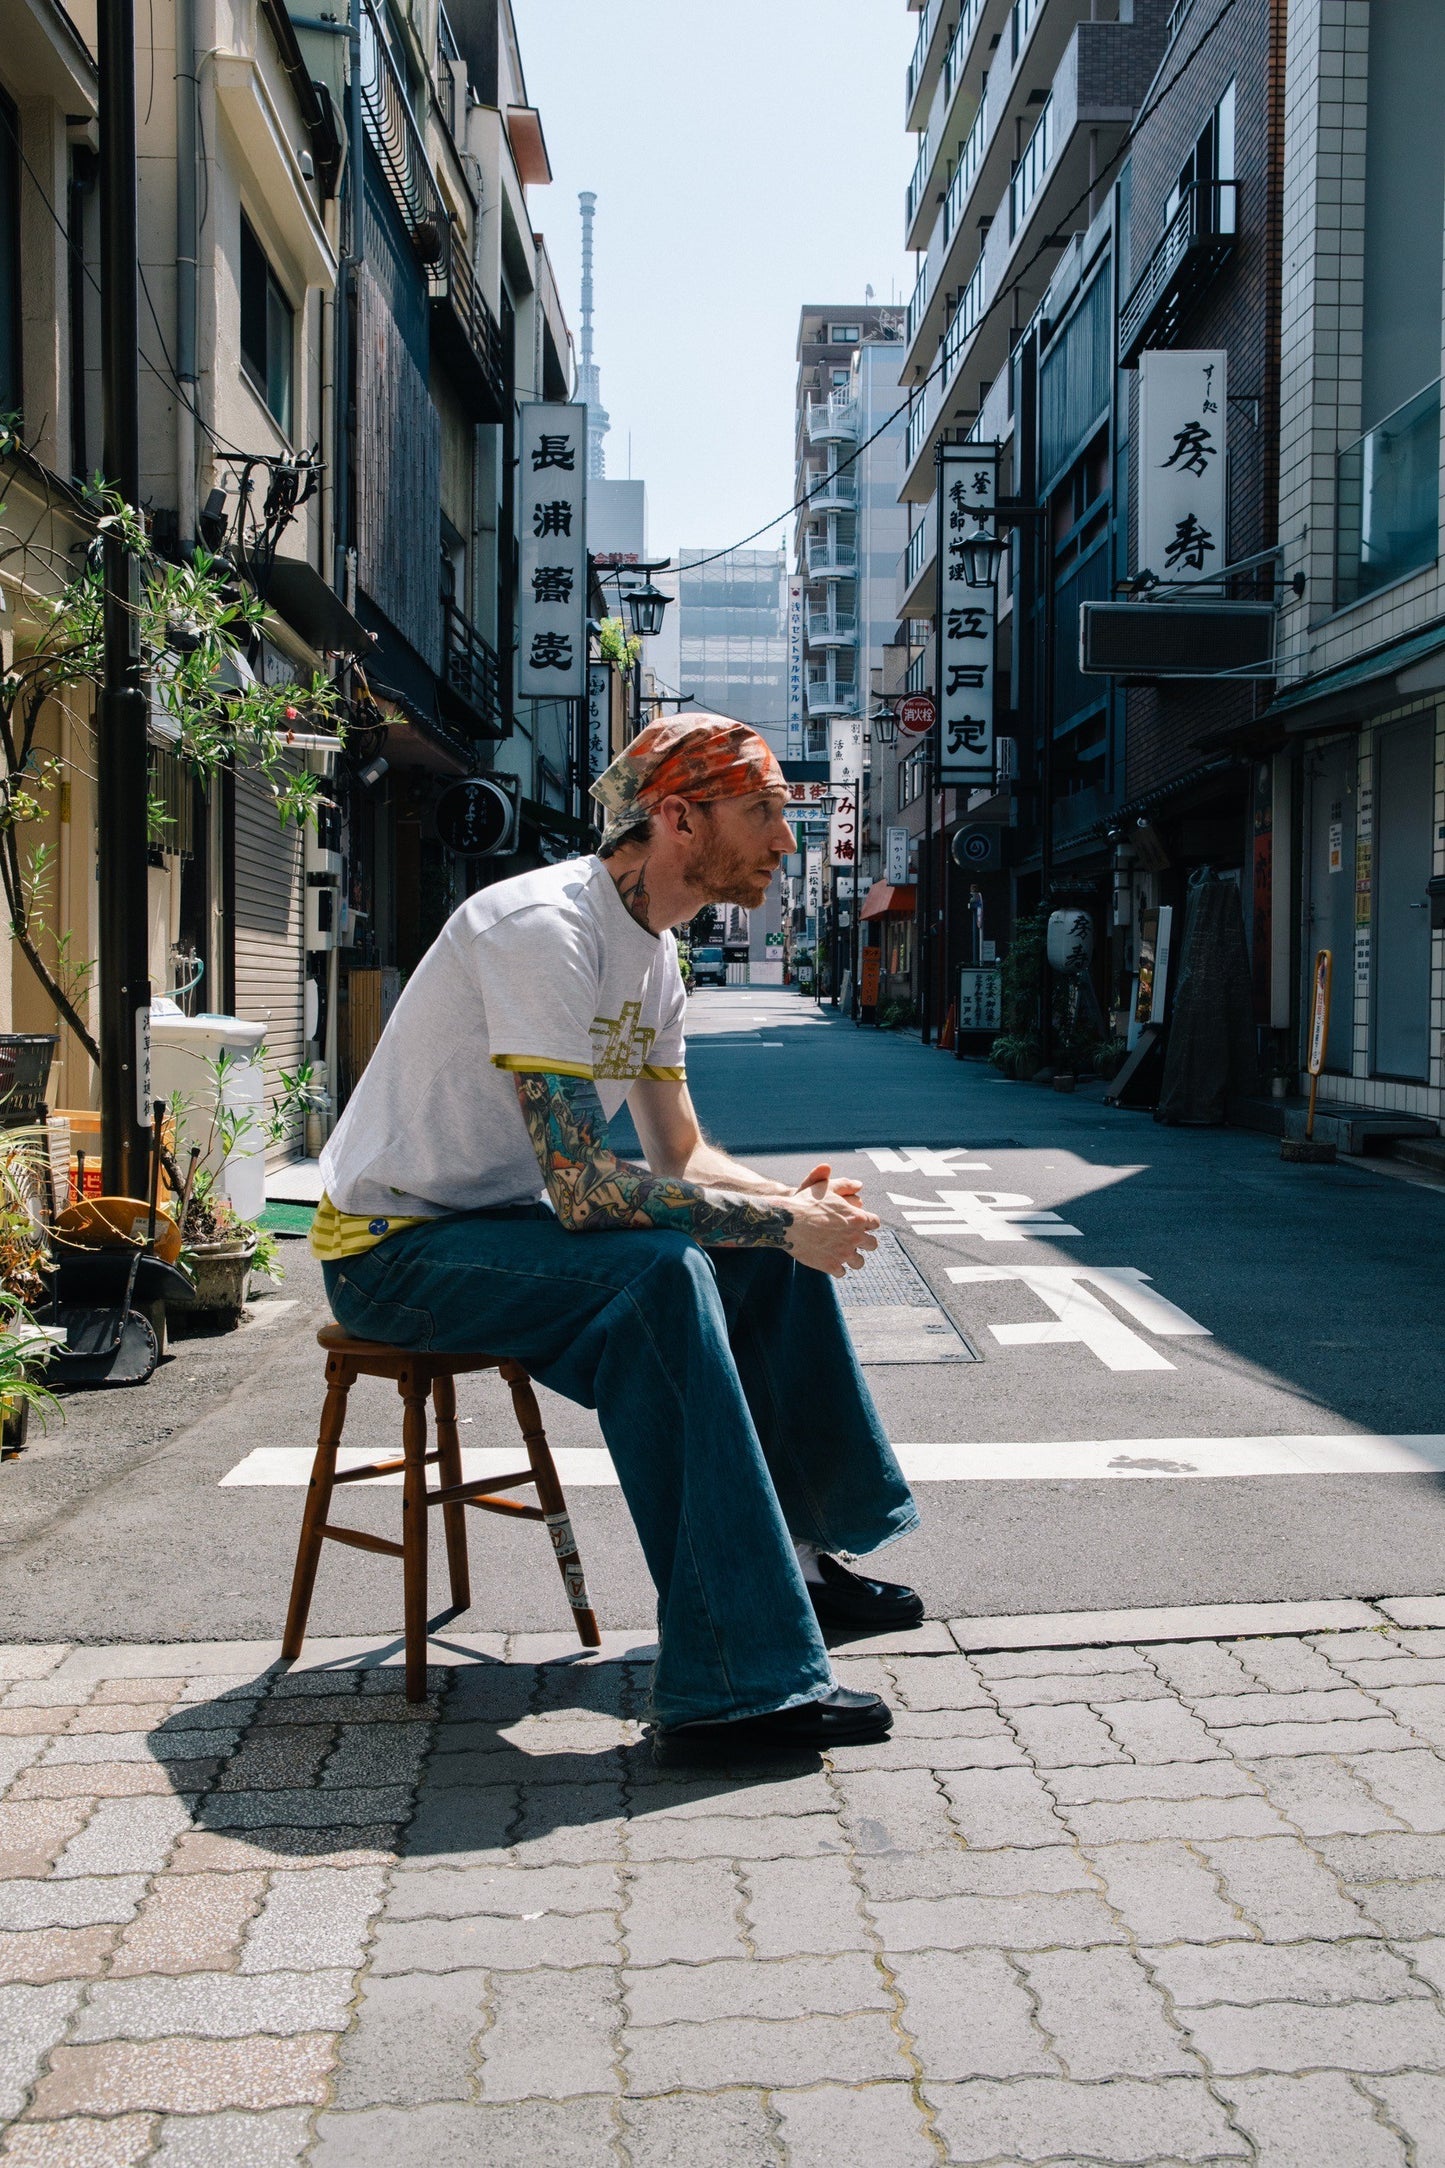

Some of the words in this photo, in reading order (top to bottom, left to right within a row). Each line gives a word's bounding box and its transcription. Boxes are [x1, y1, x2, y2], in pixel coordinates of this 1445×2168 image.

[1202, 364, 1218, 414] すし処
[1154, 420, 1218, 572] 房寿
[529, 434, 575, 672] 長浦蕎麦
[946, 607, 988, 755] 江戸定
[904, 708, 933, 722] 消火栓
[833, 739, 845, 761] 活魚
[834, 796, 856, 861] みつ橋
[1064, 915, 1090, 968] 房寿
[854, 1146, 1214, 1371] 止まれ
